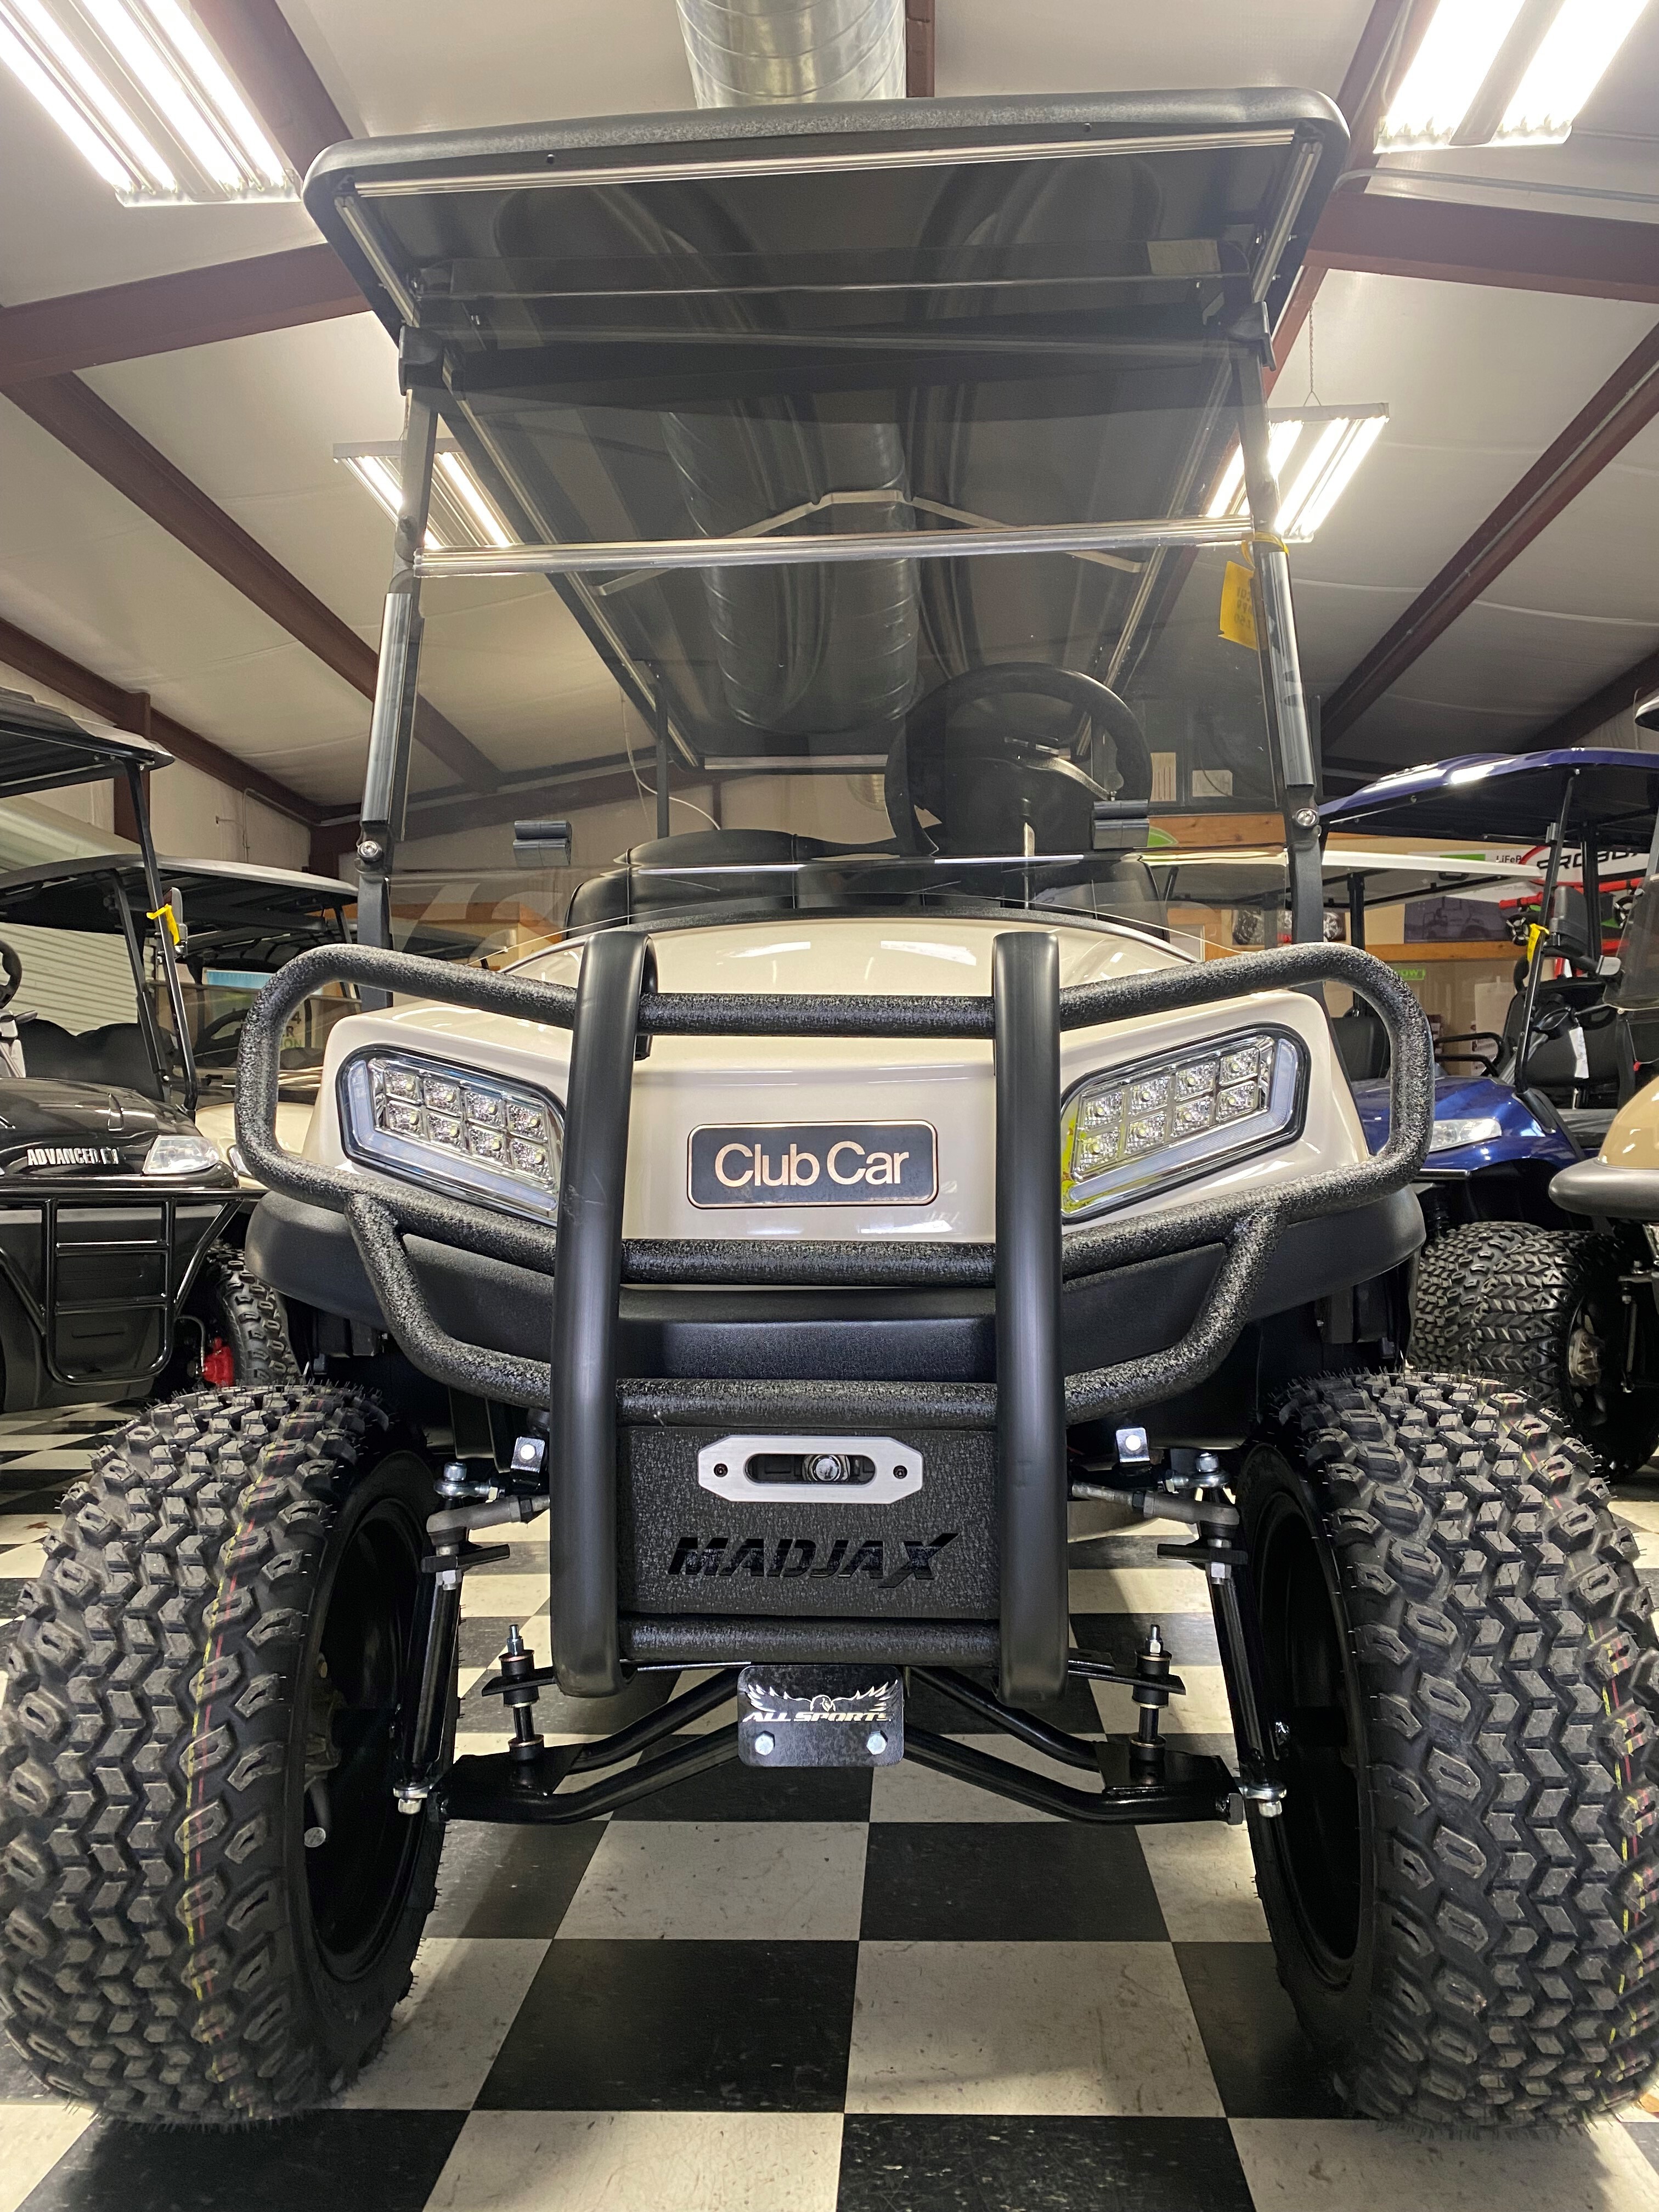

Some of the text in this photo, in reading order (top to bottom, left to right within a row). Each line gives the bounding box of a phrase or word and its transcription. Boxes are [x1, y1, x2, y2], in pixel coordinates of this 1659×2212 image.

[27, 1148, 100, 1166] ADVANCED
[715, 1141, 909, 1187] Club Car
[668, 1533, 960, 1588] MADJAX
[742, 1712, 791, 1723] ALL
